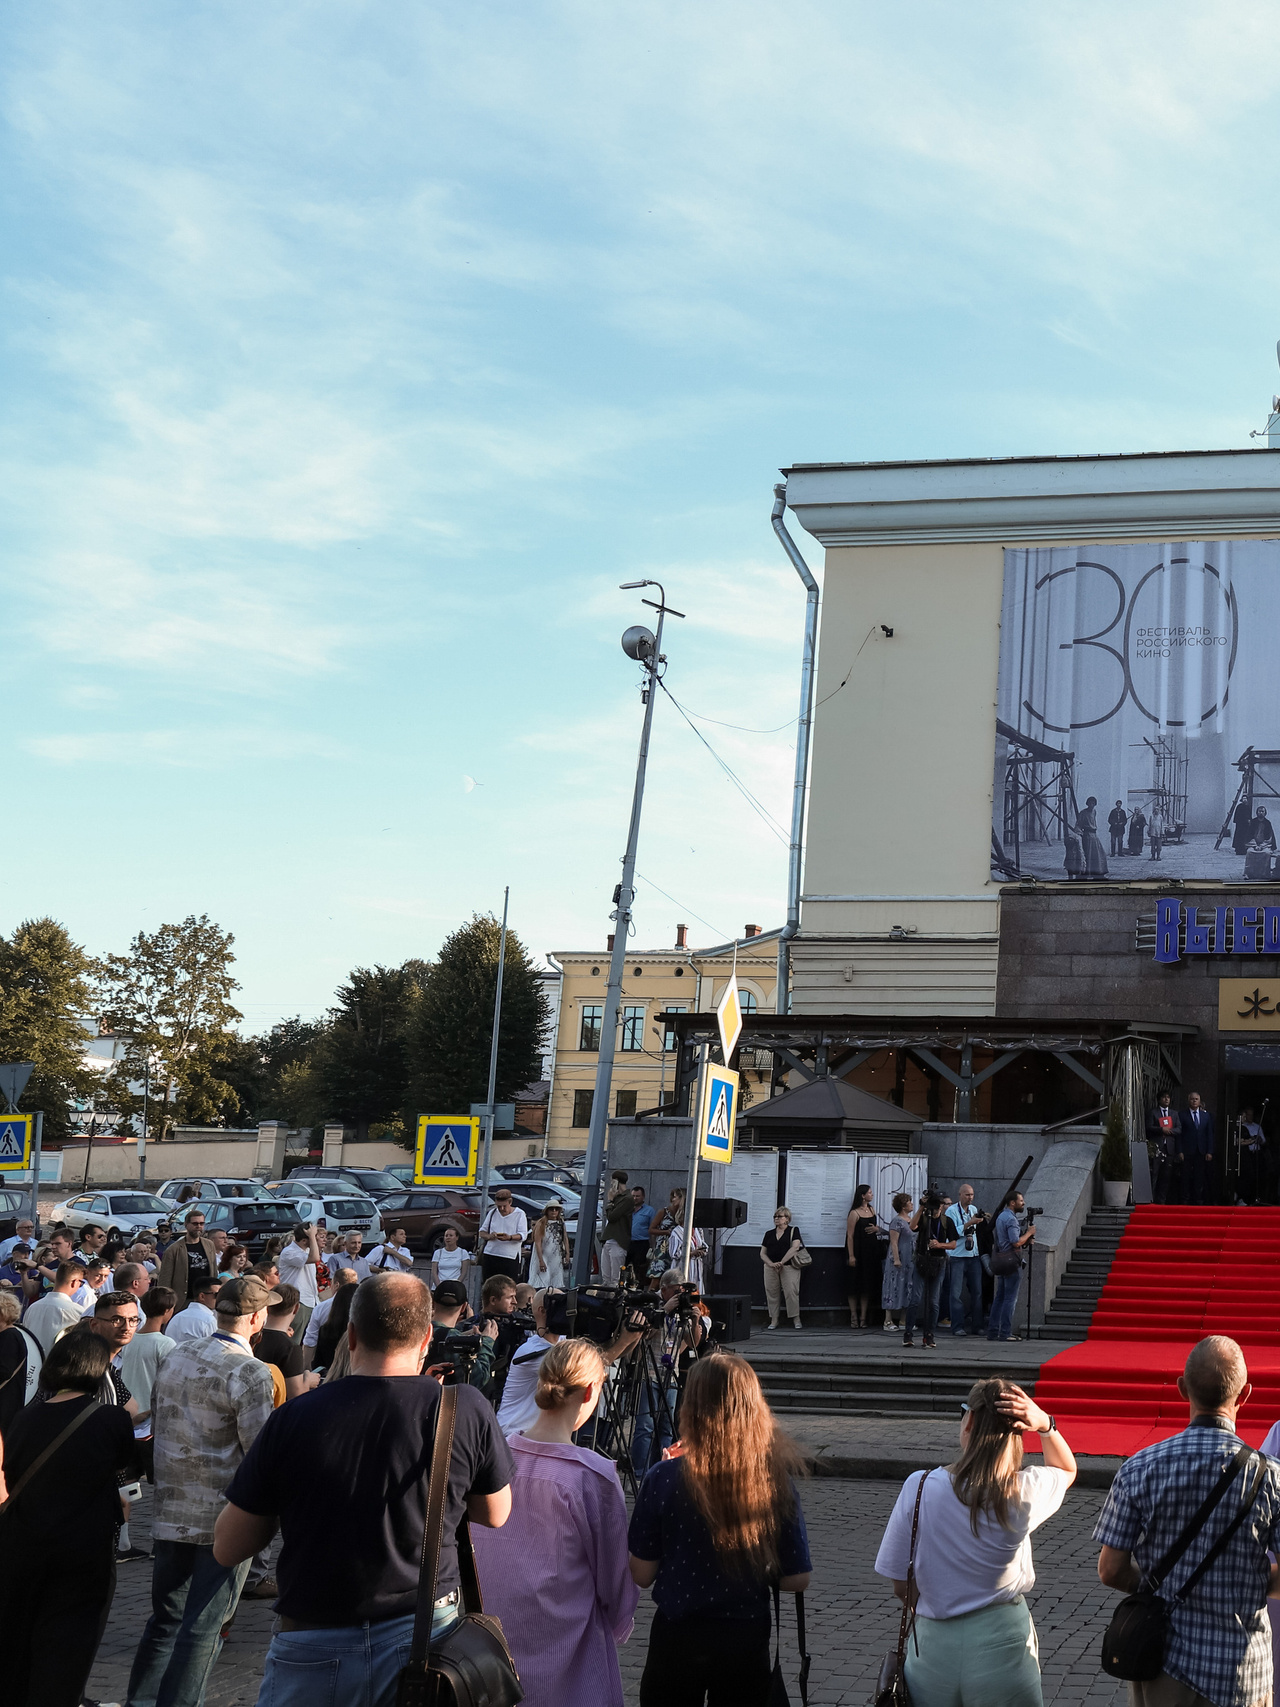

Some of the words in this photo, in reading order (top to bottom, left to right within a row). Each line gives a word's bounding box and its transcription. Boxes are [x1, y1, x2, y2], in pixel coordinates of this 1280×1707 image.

[1136, 626, 1211, 637] ФЕСТИВАЛЬ
[1023, 558, 1238, 733] 30
[1136, 636, 1228, 648] РОССИЙСКОГО
[1136, 648, 1171, 659] КИНО
